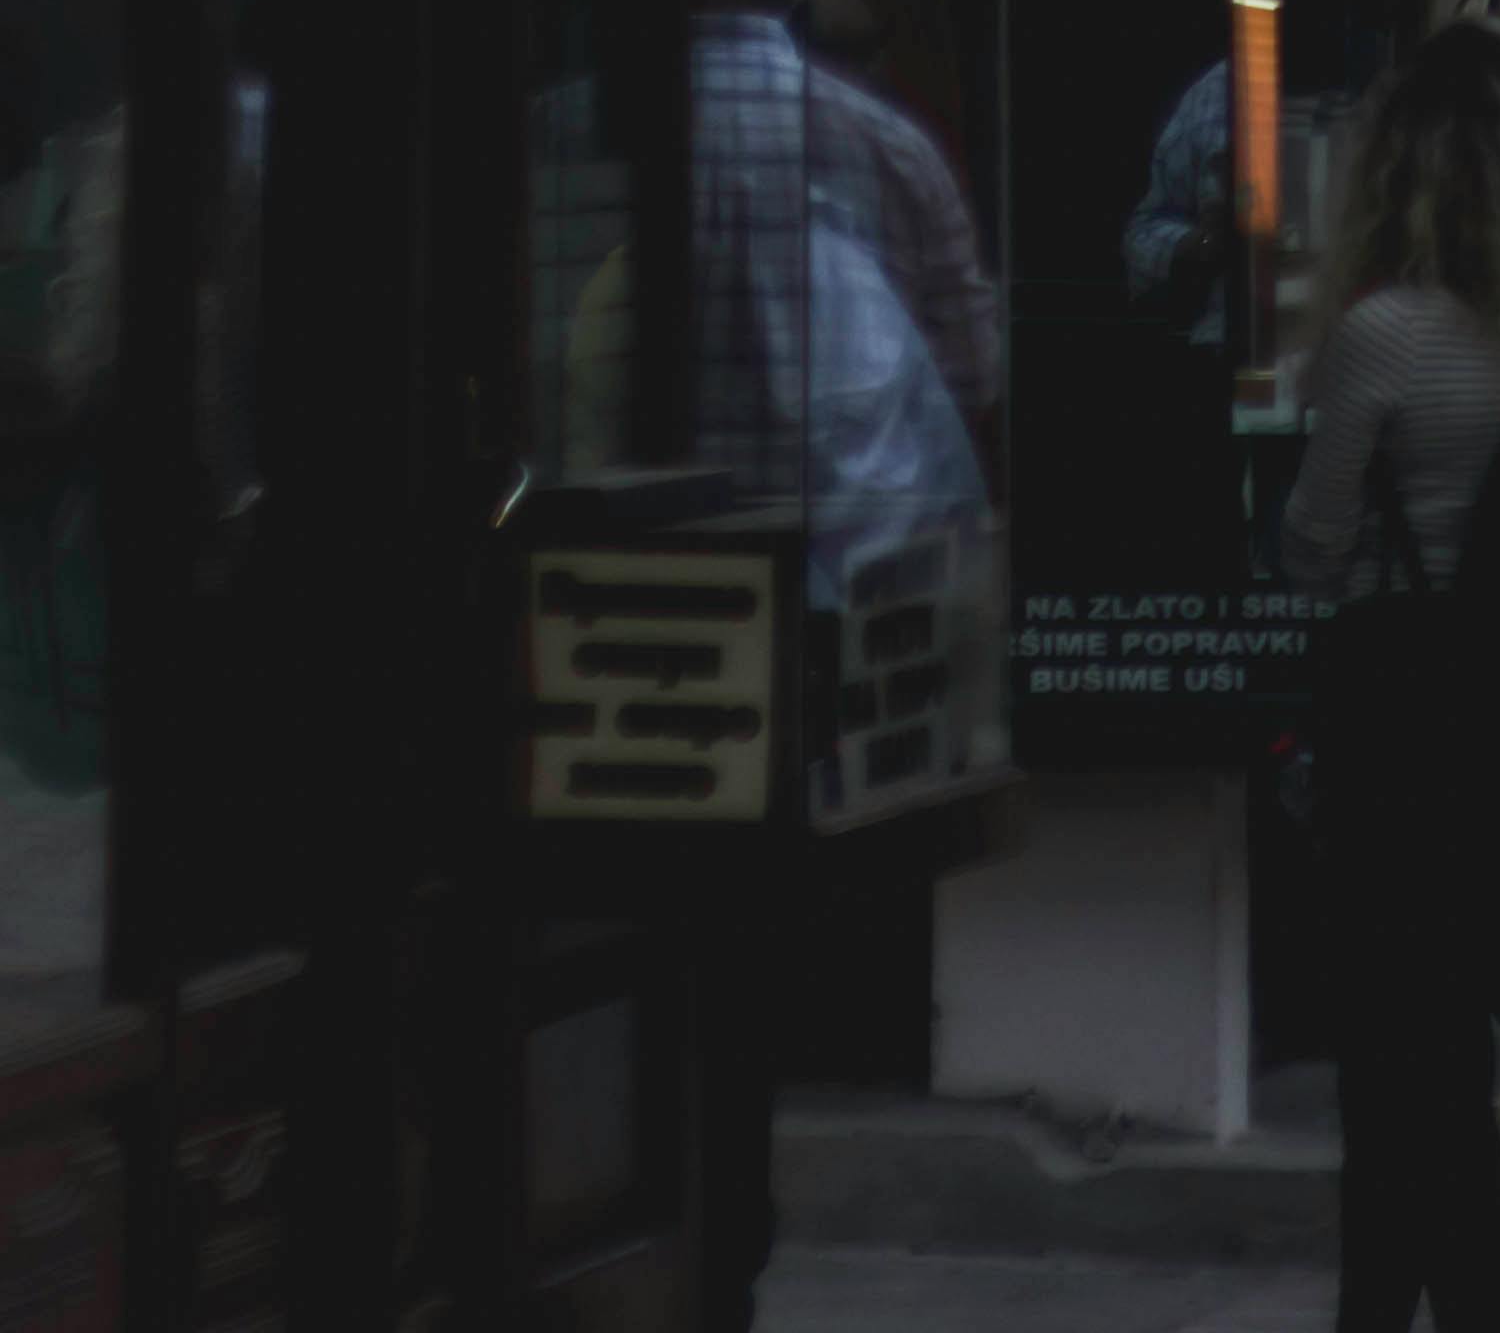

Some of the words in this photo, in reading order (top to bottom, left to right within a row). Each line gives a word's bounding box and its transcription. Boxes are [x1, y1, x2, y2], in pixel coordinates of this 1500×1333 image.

[1024, 593, 1075, 620] NA
[1087, 593, 1206, 621] ZLATO
[1120, 629, 1308, 657] POPRAVKI
[1029, 662, 1172, 694] BUŠIME
[1184, 662, 1247, 693] UŠI
